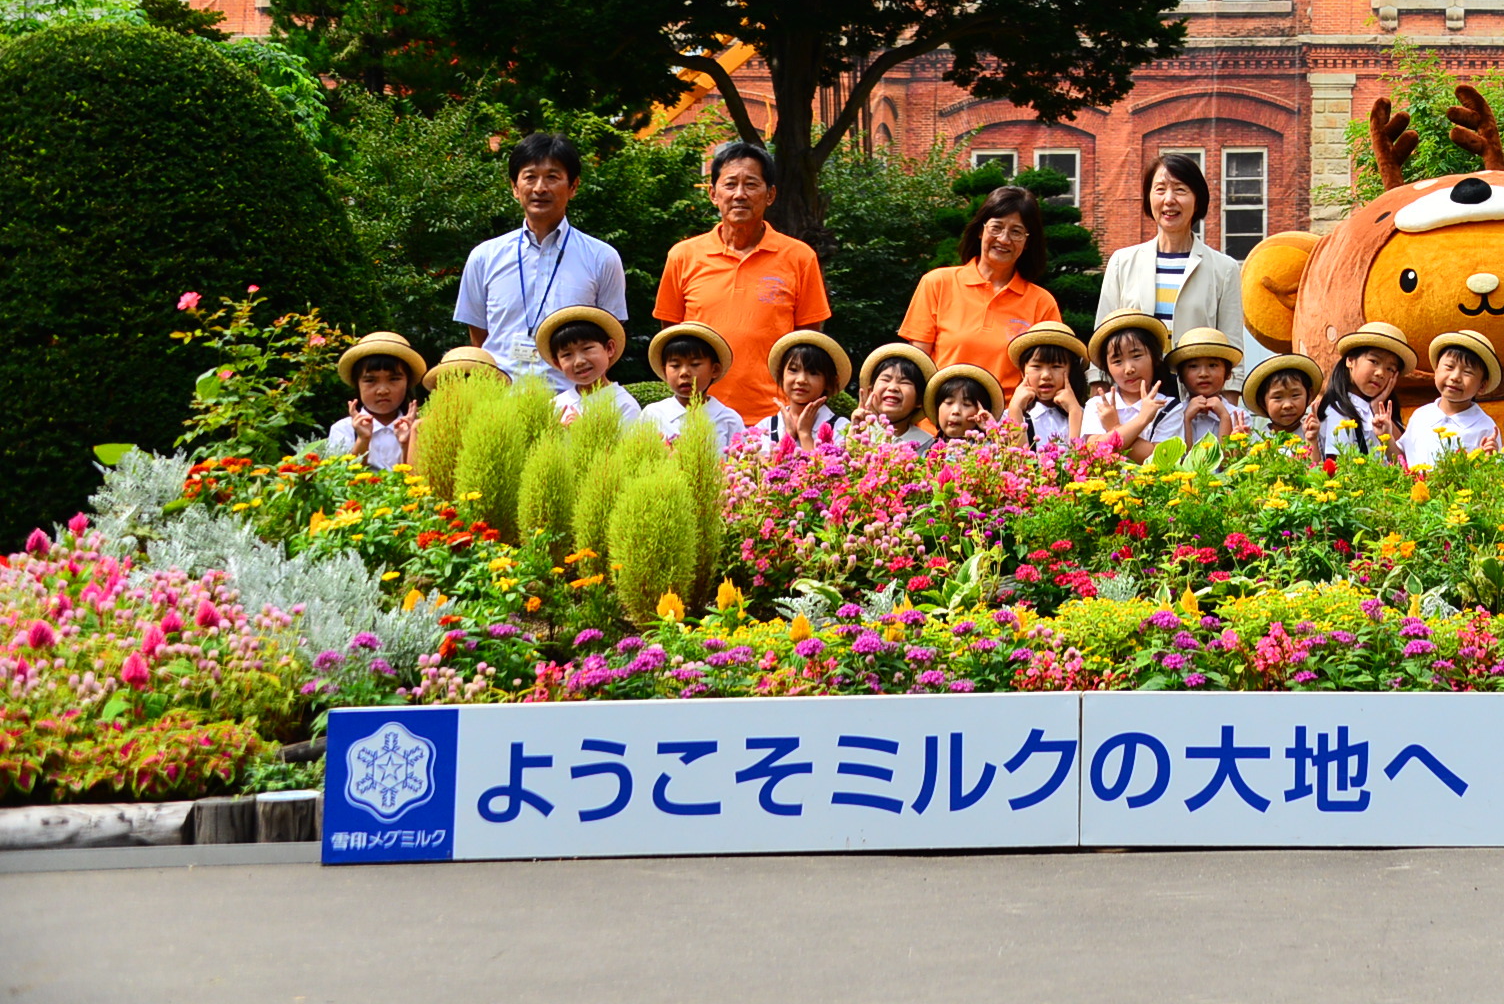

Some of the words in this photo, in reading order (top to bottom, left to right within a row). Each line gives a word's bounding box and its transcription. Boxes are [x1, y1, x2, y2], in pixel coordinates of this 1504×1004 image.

[477, 725, 1469, 823] ようこそミルクの大地へ
[331, 829, 446, 851] 雪印メグミルク
